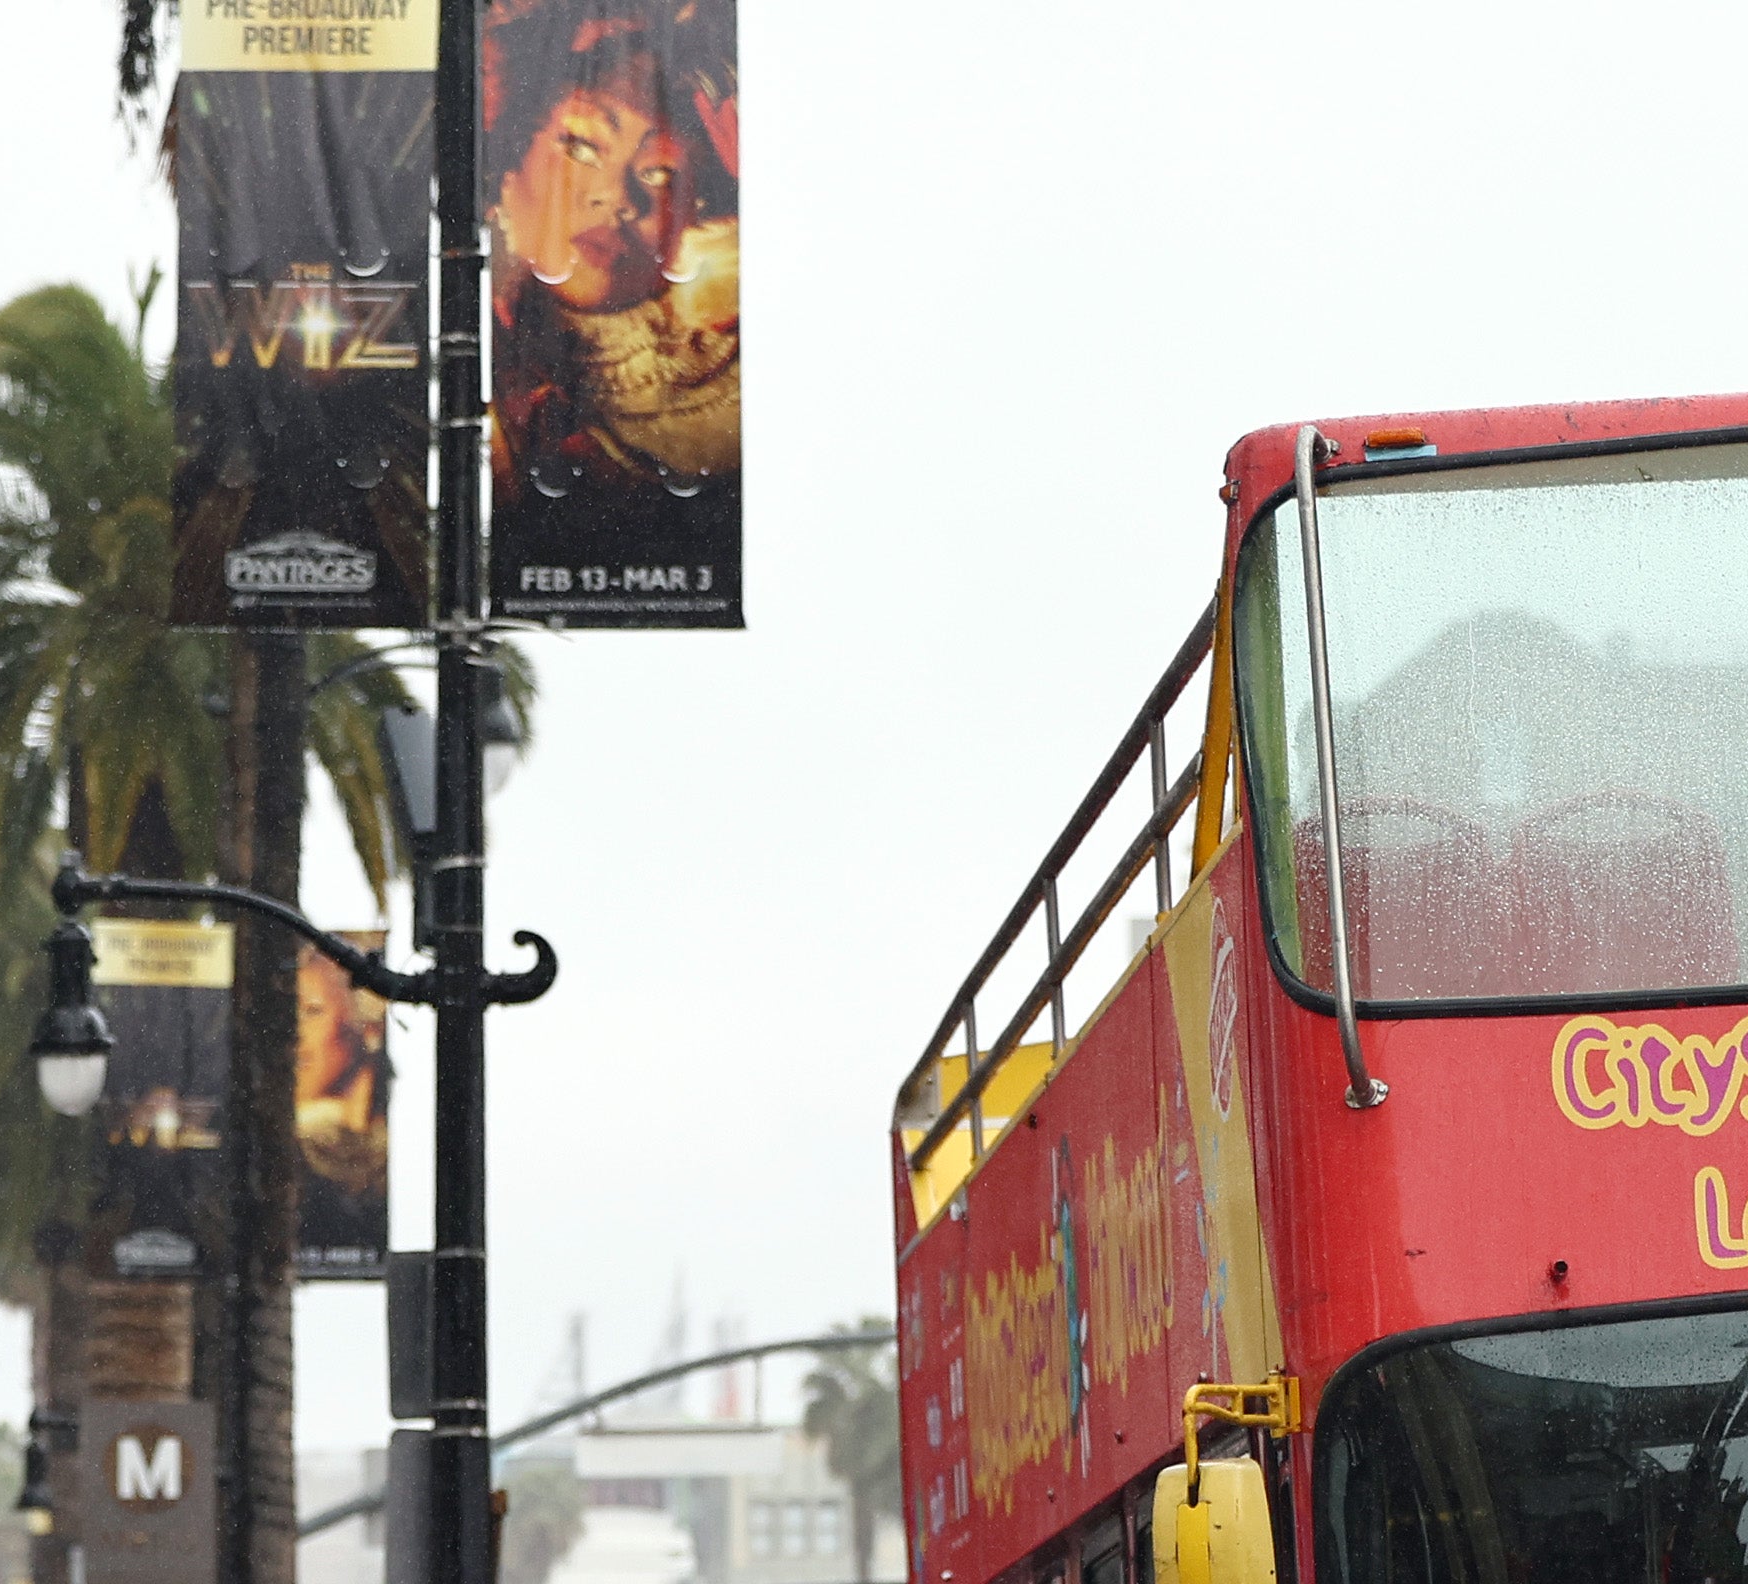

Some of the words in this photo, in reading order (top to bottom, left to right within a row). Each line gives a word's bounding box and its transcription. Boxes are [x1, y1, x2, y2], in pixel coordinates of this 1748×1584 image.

[242, 25, 373, 56] PREMIERE
[291, 262, 332, 280] THE
[186, 280, 420, 370] WIZ
[230, 555, 370, 585] PANTAGES
[519, 566, 573, 592] FEB
[695, 566, 714, 592] 3
[114, 1435, 182, 1500] M
